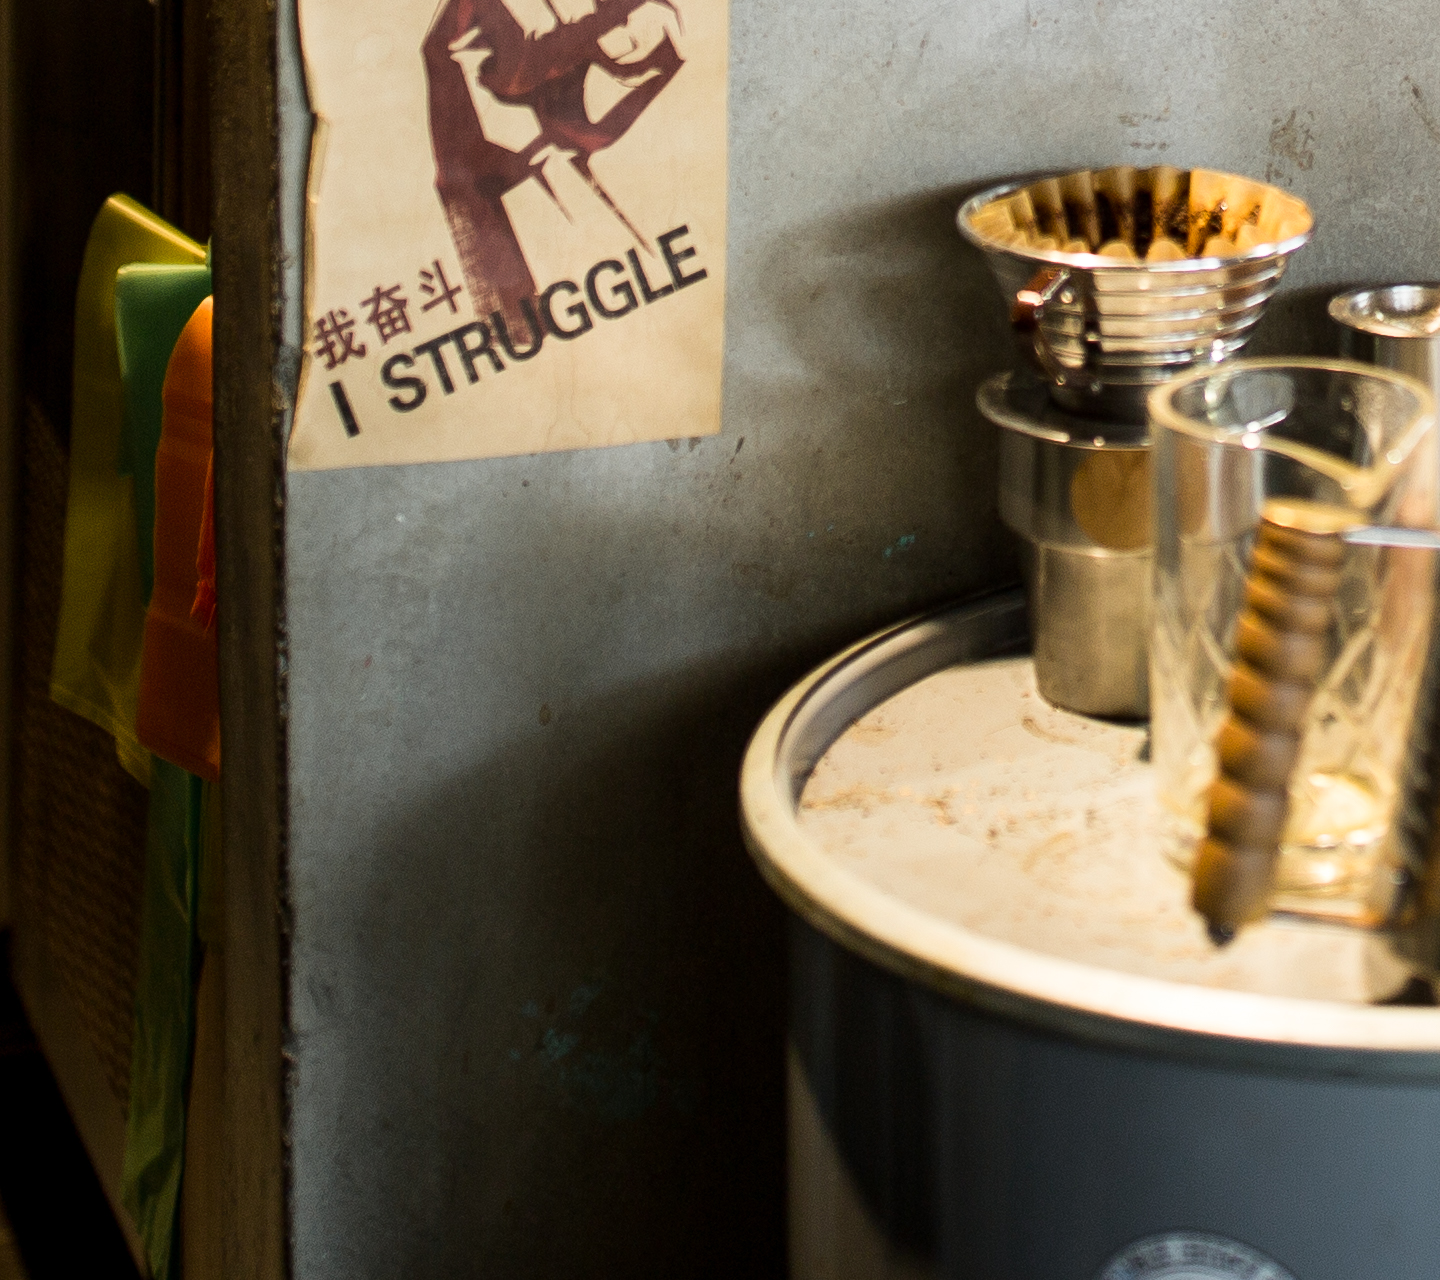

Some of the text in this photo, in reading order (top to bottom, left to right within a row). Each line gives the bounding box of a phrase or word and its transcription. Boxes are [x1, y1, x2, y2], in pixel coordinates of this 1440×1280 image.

[313, 259, 463, 371] 我奋斗
[328, 224, 709, 439] I STRUGGLE
